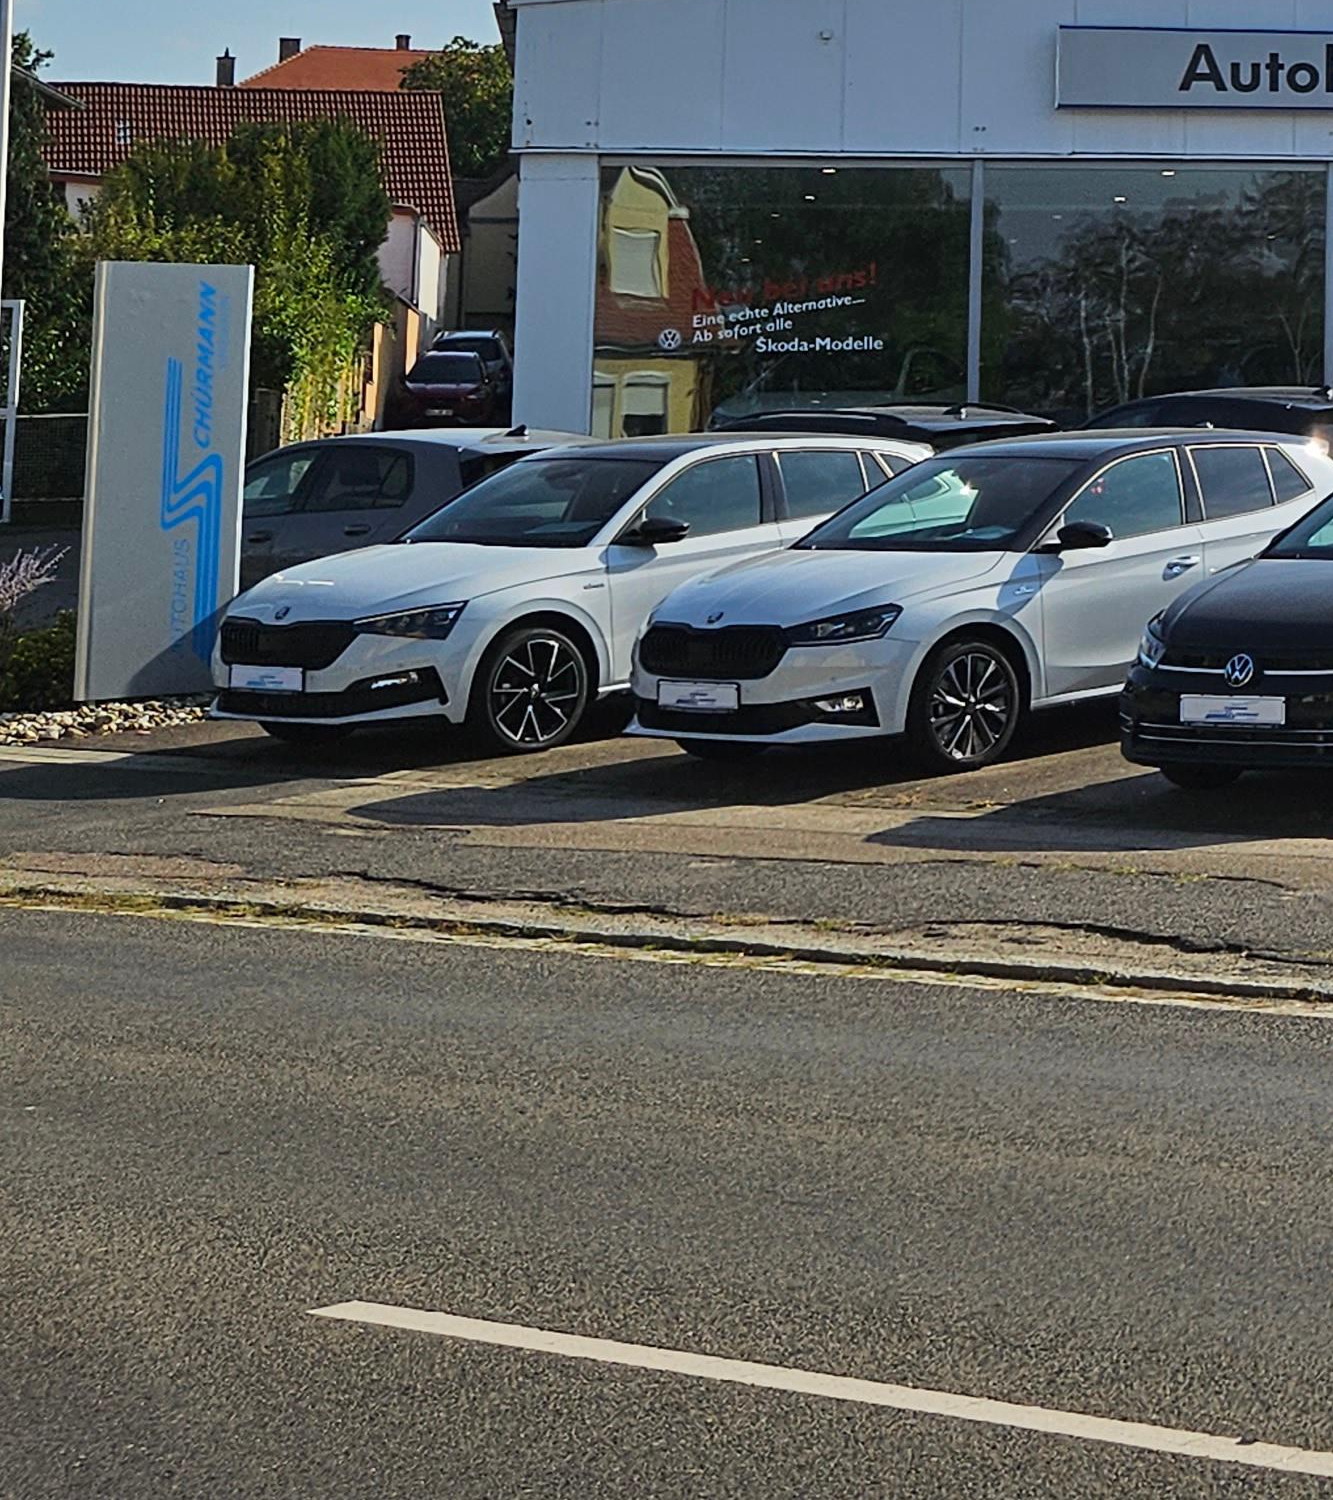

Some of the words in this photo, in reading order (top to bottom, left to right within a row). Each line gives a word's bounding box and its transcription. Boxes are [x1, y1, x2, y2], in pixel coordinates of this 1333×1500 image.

[816, 260, 878, 293] uns!
[693, 313, 725, 329] Eine
[728, 307, 770, 323] echte
[692, 329, 713, 344] Ab
[717, 323, 762, 340] sofort
[766, 317, 793, 331] alle
[755, 336, 884, 353] Škoda-Modelle
